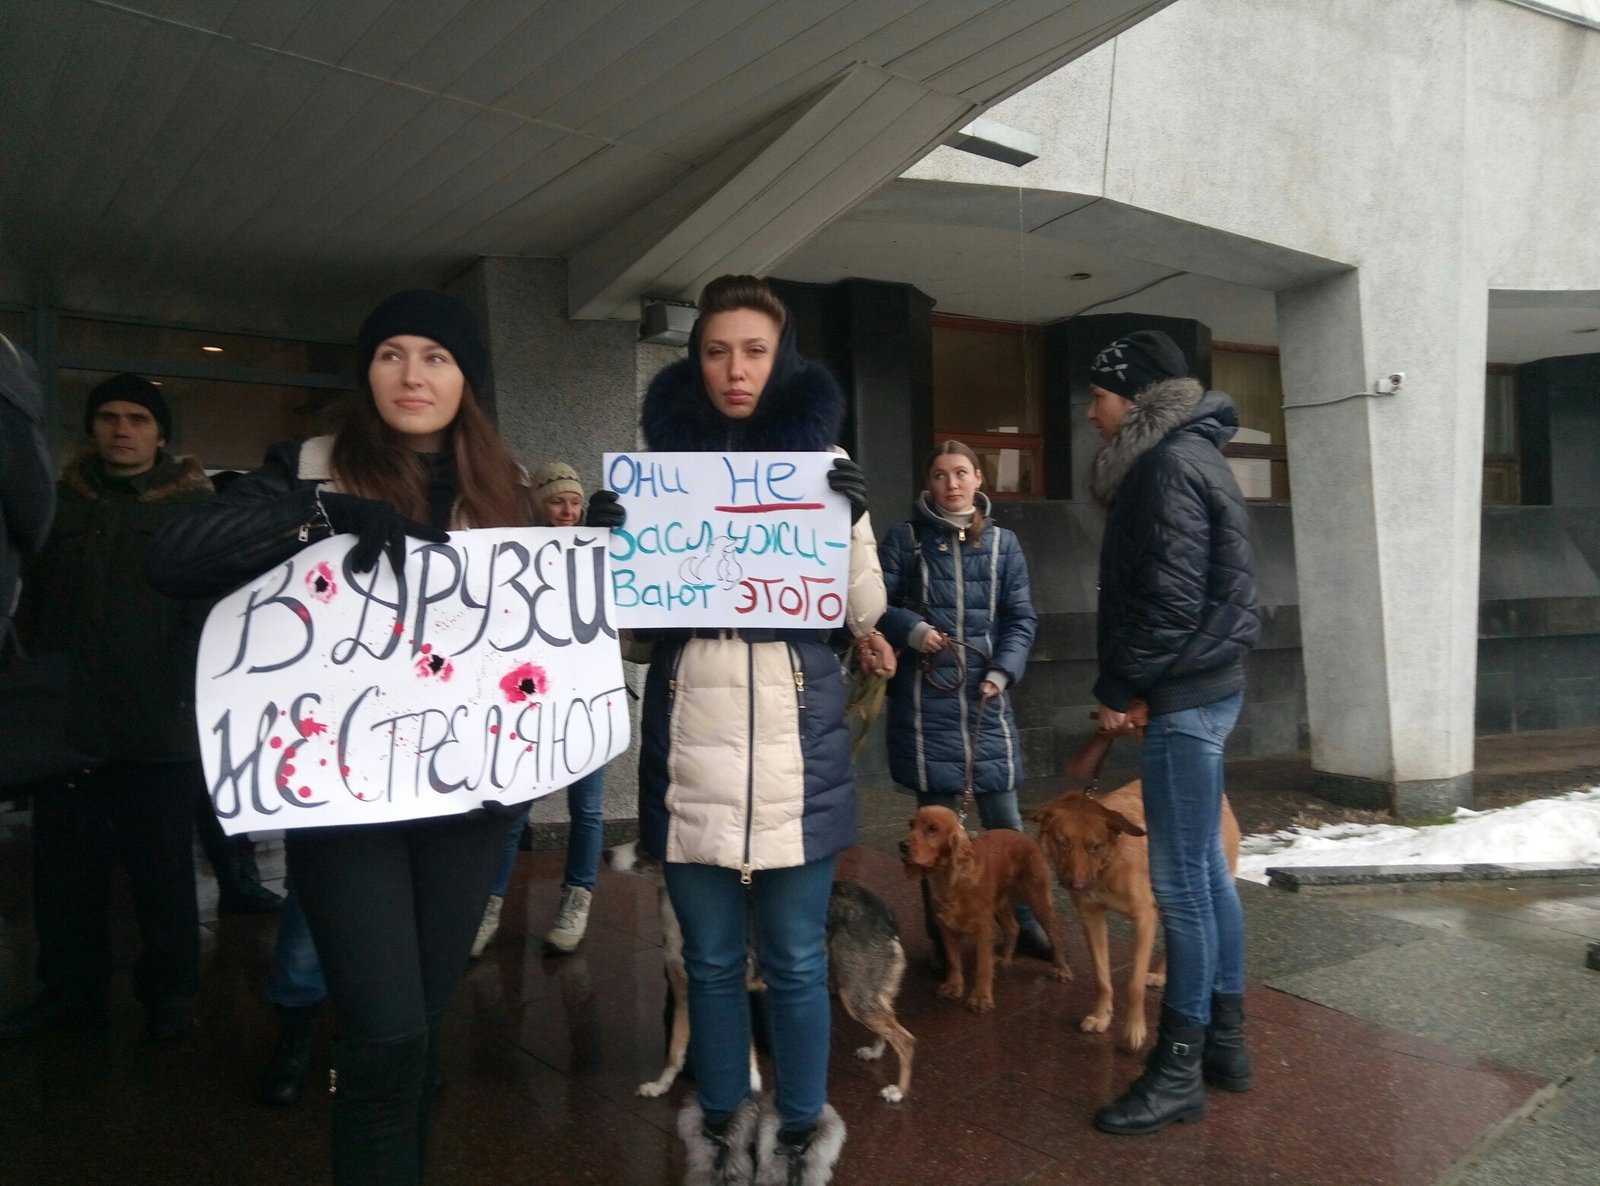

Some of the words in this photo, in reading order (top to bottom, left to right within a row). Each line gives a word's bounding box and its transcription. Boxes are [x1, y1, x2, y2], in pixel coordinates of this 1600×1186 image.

[609, 455, 689, 497] Они
[211, 560, 314, 680] В
[331, 534, 618, 665] ДРУЗЕЙ
[211, 692, 330, 819] НЕ
